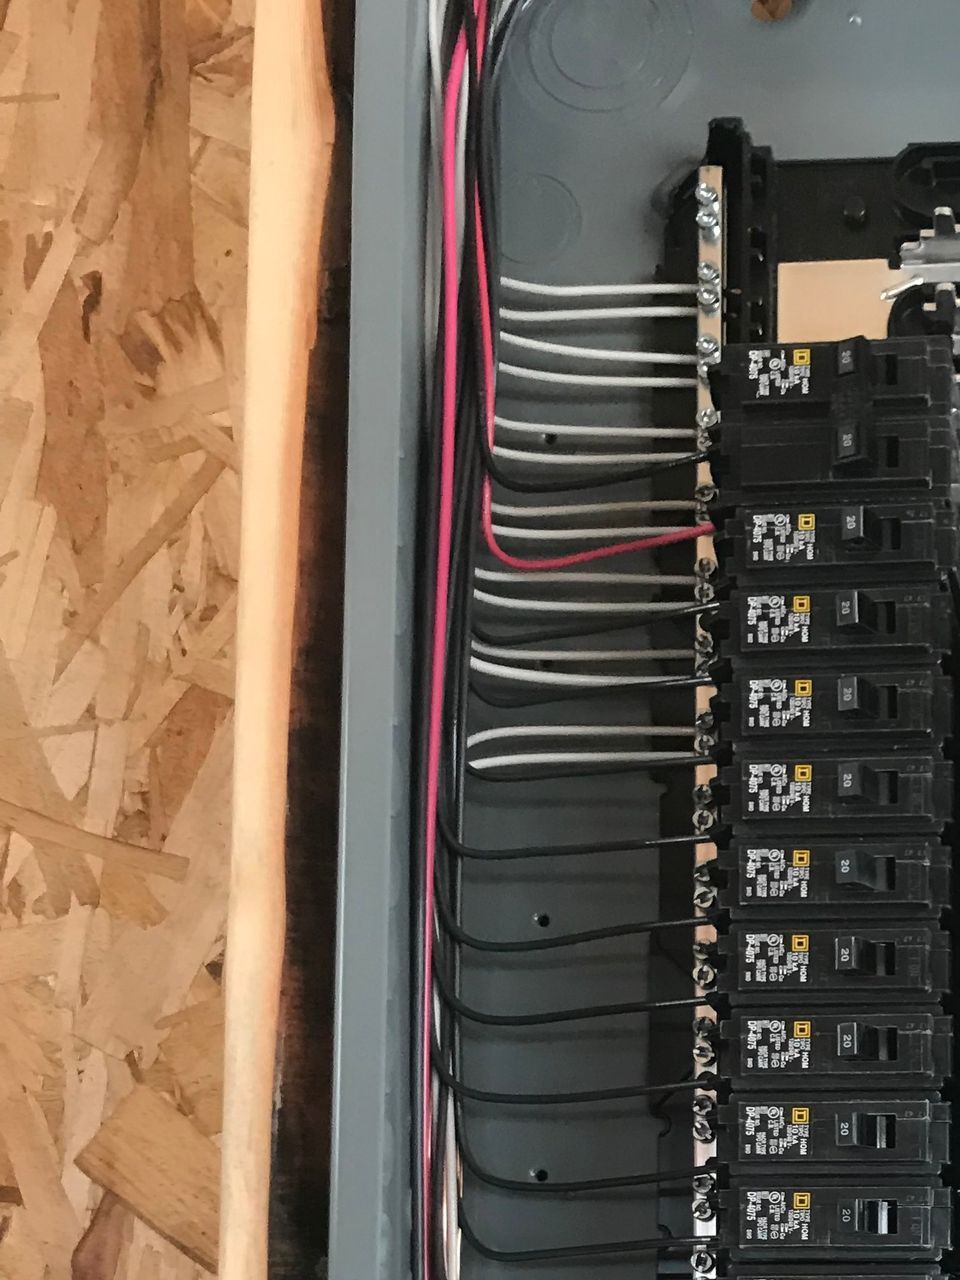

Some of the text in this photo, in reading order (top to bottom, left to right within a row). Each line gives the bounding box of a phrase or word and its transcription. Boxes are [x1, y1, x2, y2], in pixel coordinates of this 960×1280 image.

[843, 434, 852, 446] 20
[847, 516, 856, 529] 20
[842, 601, 850, 614] 20
[844, 688, 852, 701] 20
[844, 774, 851, 787] 20
[841, 860, 849, 872] 20
[841, 948, 849, 961] 20
[843, 1035, 851, 1047] 20
[841, 1123, 848, 1135] 20
[843, 1209, 850, 1222] 20
